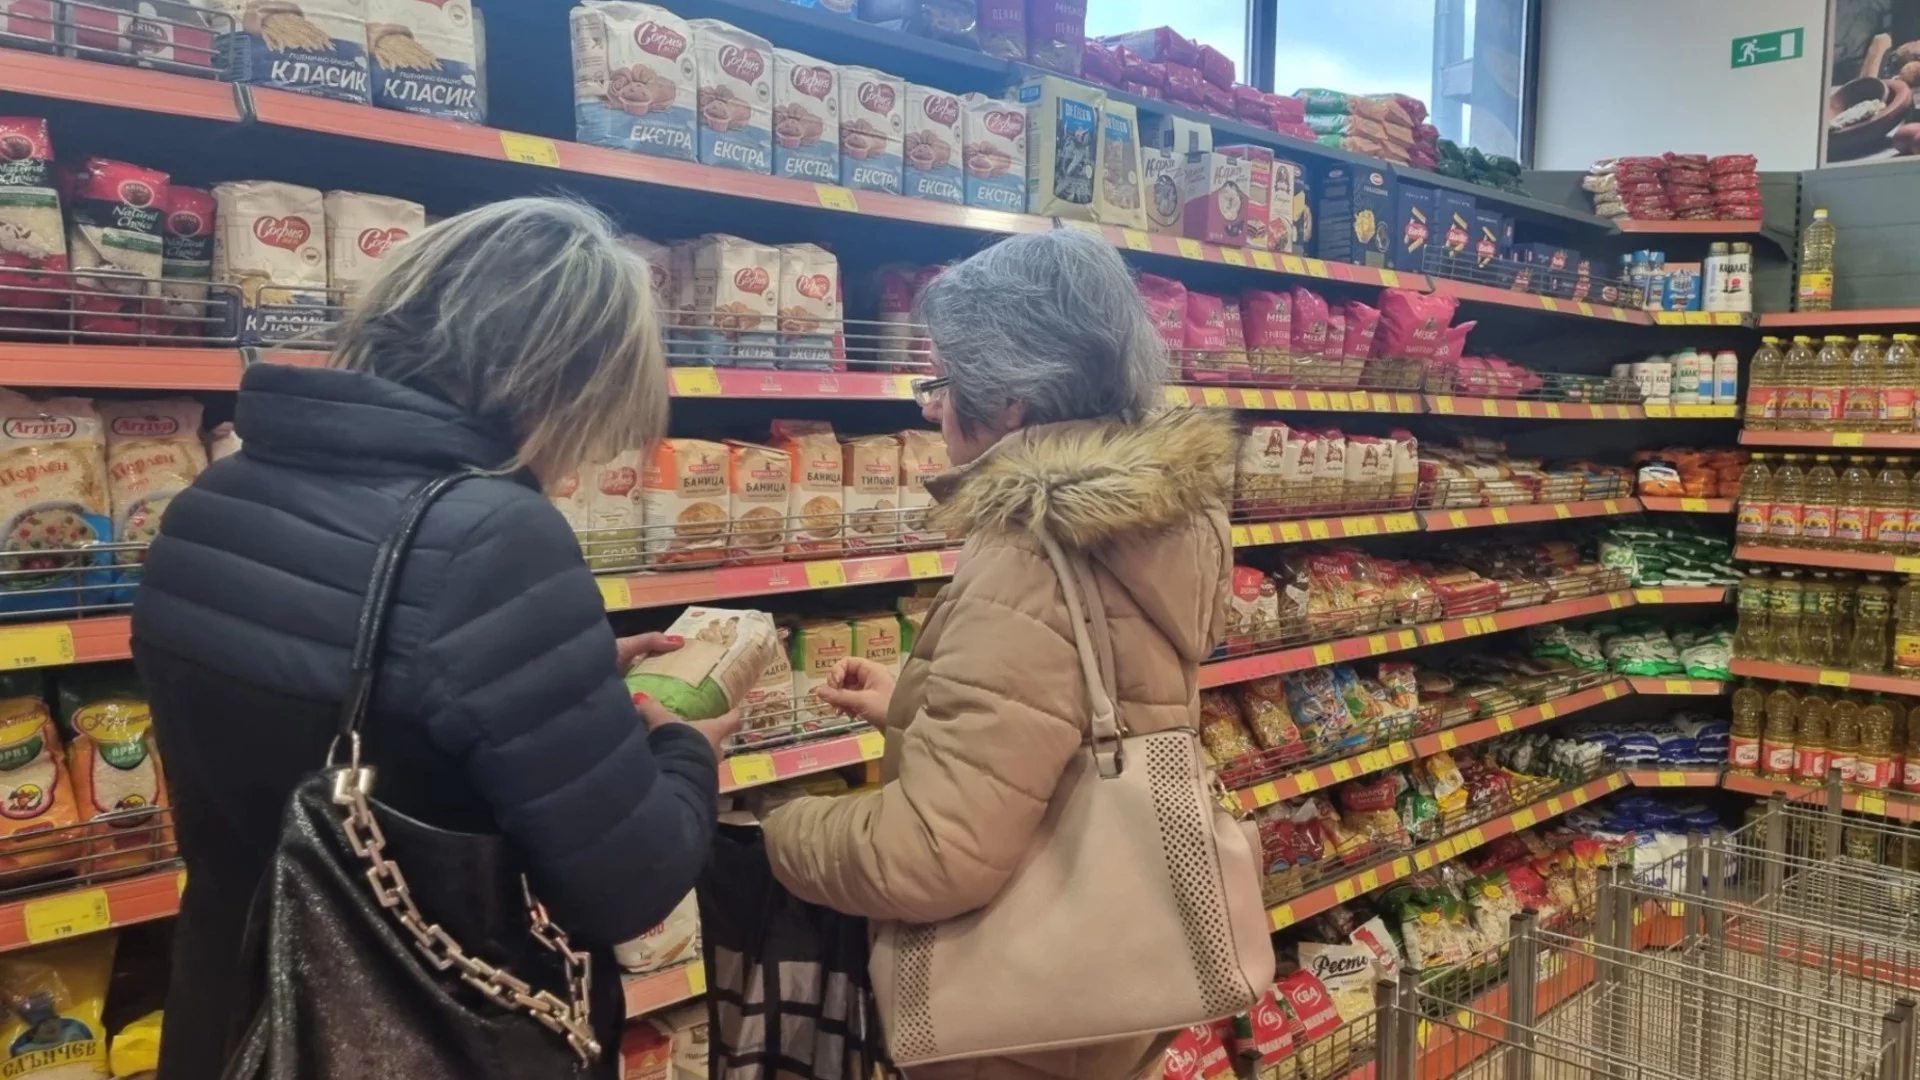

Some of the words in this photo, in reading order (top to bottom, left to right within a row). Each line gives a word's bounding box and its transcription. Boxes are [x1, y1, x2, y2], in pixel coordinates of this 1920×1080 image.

[638, 23, 683, 52] София
[721, 46, 760, 75] София
[271, 60, 367, 92] КЛАСИК
[793, 65, 830, 95] София
[385, 78, 476, 109] КЛАСИК
[630, 125, 692, 149] ЕКСТРА
[713, 141, 765, 166] ЕКСТРА
[785, 158, 834, 178] ЕКСТРА
[853, 168, 898, 189] ЕКСТРА
[918, 179, 961, 201] ЕКСТРА
[978, 187, 1023, 207] ЕКСТРА
[112, 205, 159, 221] Natural
[117, 216, 154, 232] Choice
[256, 217, 305, 244] София
[164, 236, 206, 250] Natural
[166, 246, 202, 260] Choice
[11, 419, 72, 435] Arriva
[117, 419, 174, 434] Arriva
[683, 476, 725, 488] БАНИЦА
[745, 482, 786, 492] БАНИЦА
[807, 471, 841, 483] БАНИЦА
[861, 475, 895, 486] ТИПОВО
[866, 647, 897, 659] ЕКСТРА
[815, 658, 842, 669] ЕКСТ
[2, 1041, 97, 1080] СЛЪНЧЕВ
